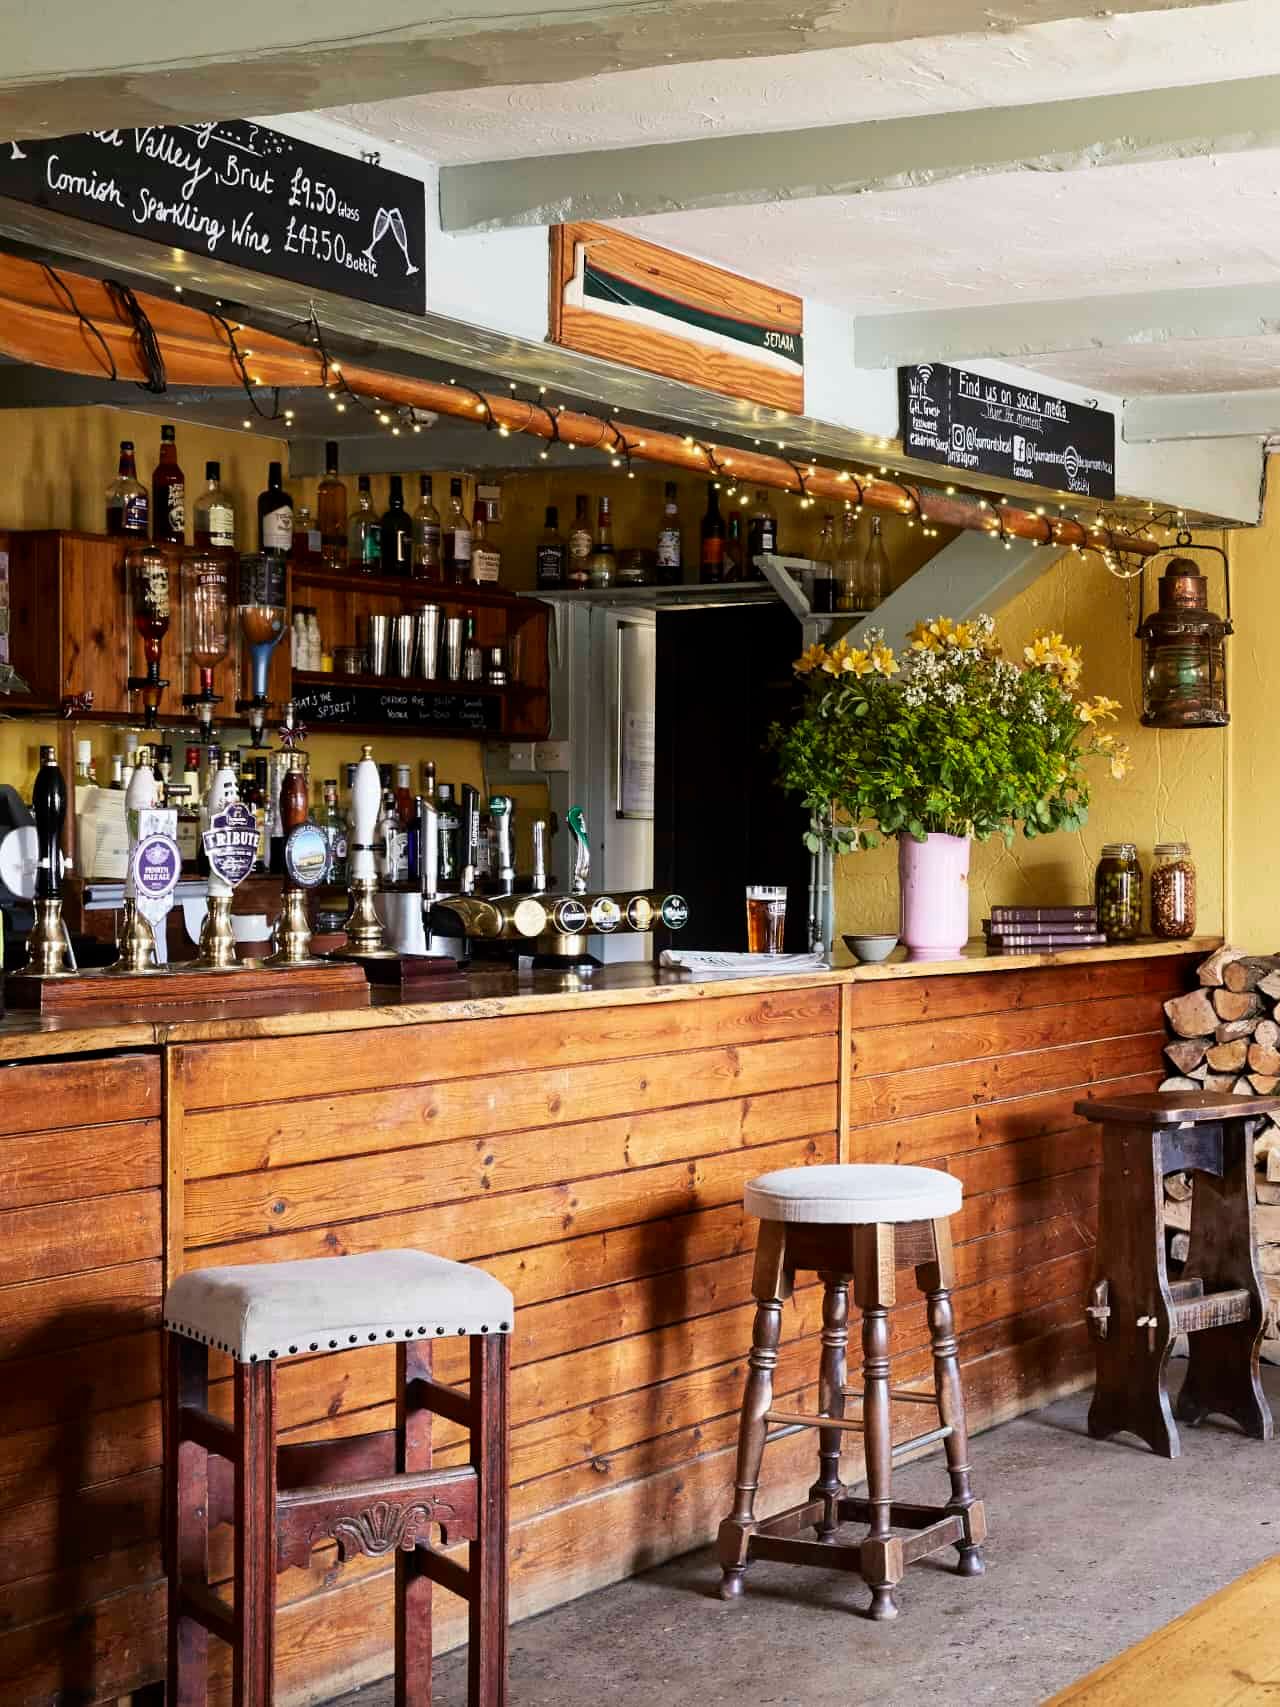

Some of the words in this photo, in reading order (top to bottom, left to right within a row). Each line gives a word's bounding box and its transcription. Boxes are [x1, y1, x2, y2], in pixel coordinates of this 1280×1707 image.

[220, 155, 274, 194] Brut
[288, 167, 336, 215] £9.50
[337, 200, 360, 222] Glass
[47, 154, 125, 208] Cornish
[132, 188, 226, 251] Sparkling
[231, 212, 272, 255] Wine
[284, 216, 346, 264] £47.50
[345, 253, 378, 277] Bottle
[959, 371, 980, 397] Find
[985, 384, 998, 402] us
[1001, 390, 1012, 405] on
[1017, 391, 1041, 412] social
[1045, 400, 1067, 419] media
[204, 832, 260, 849] TRIBUTE
